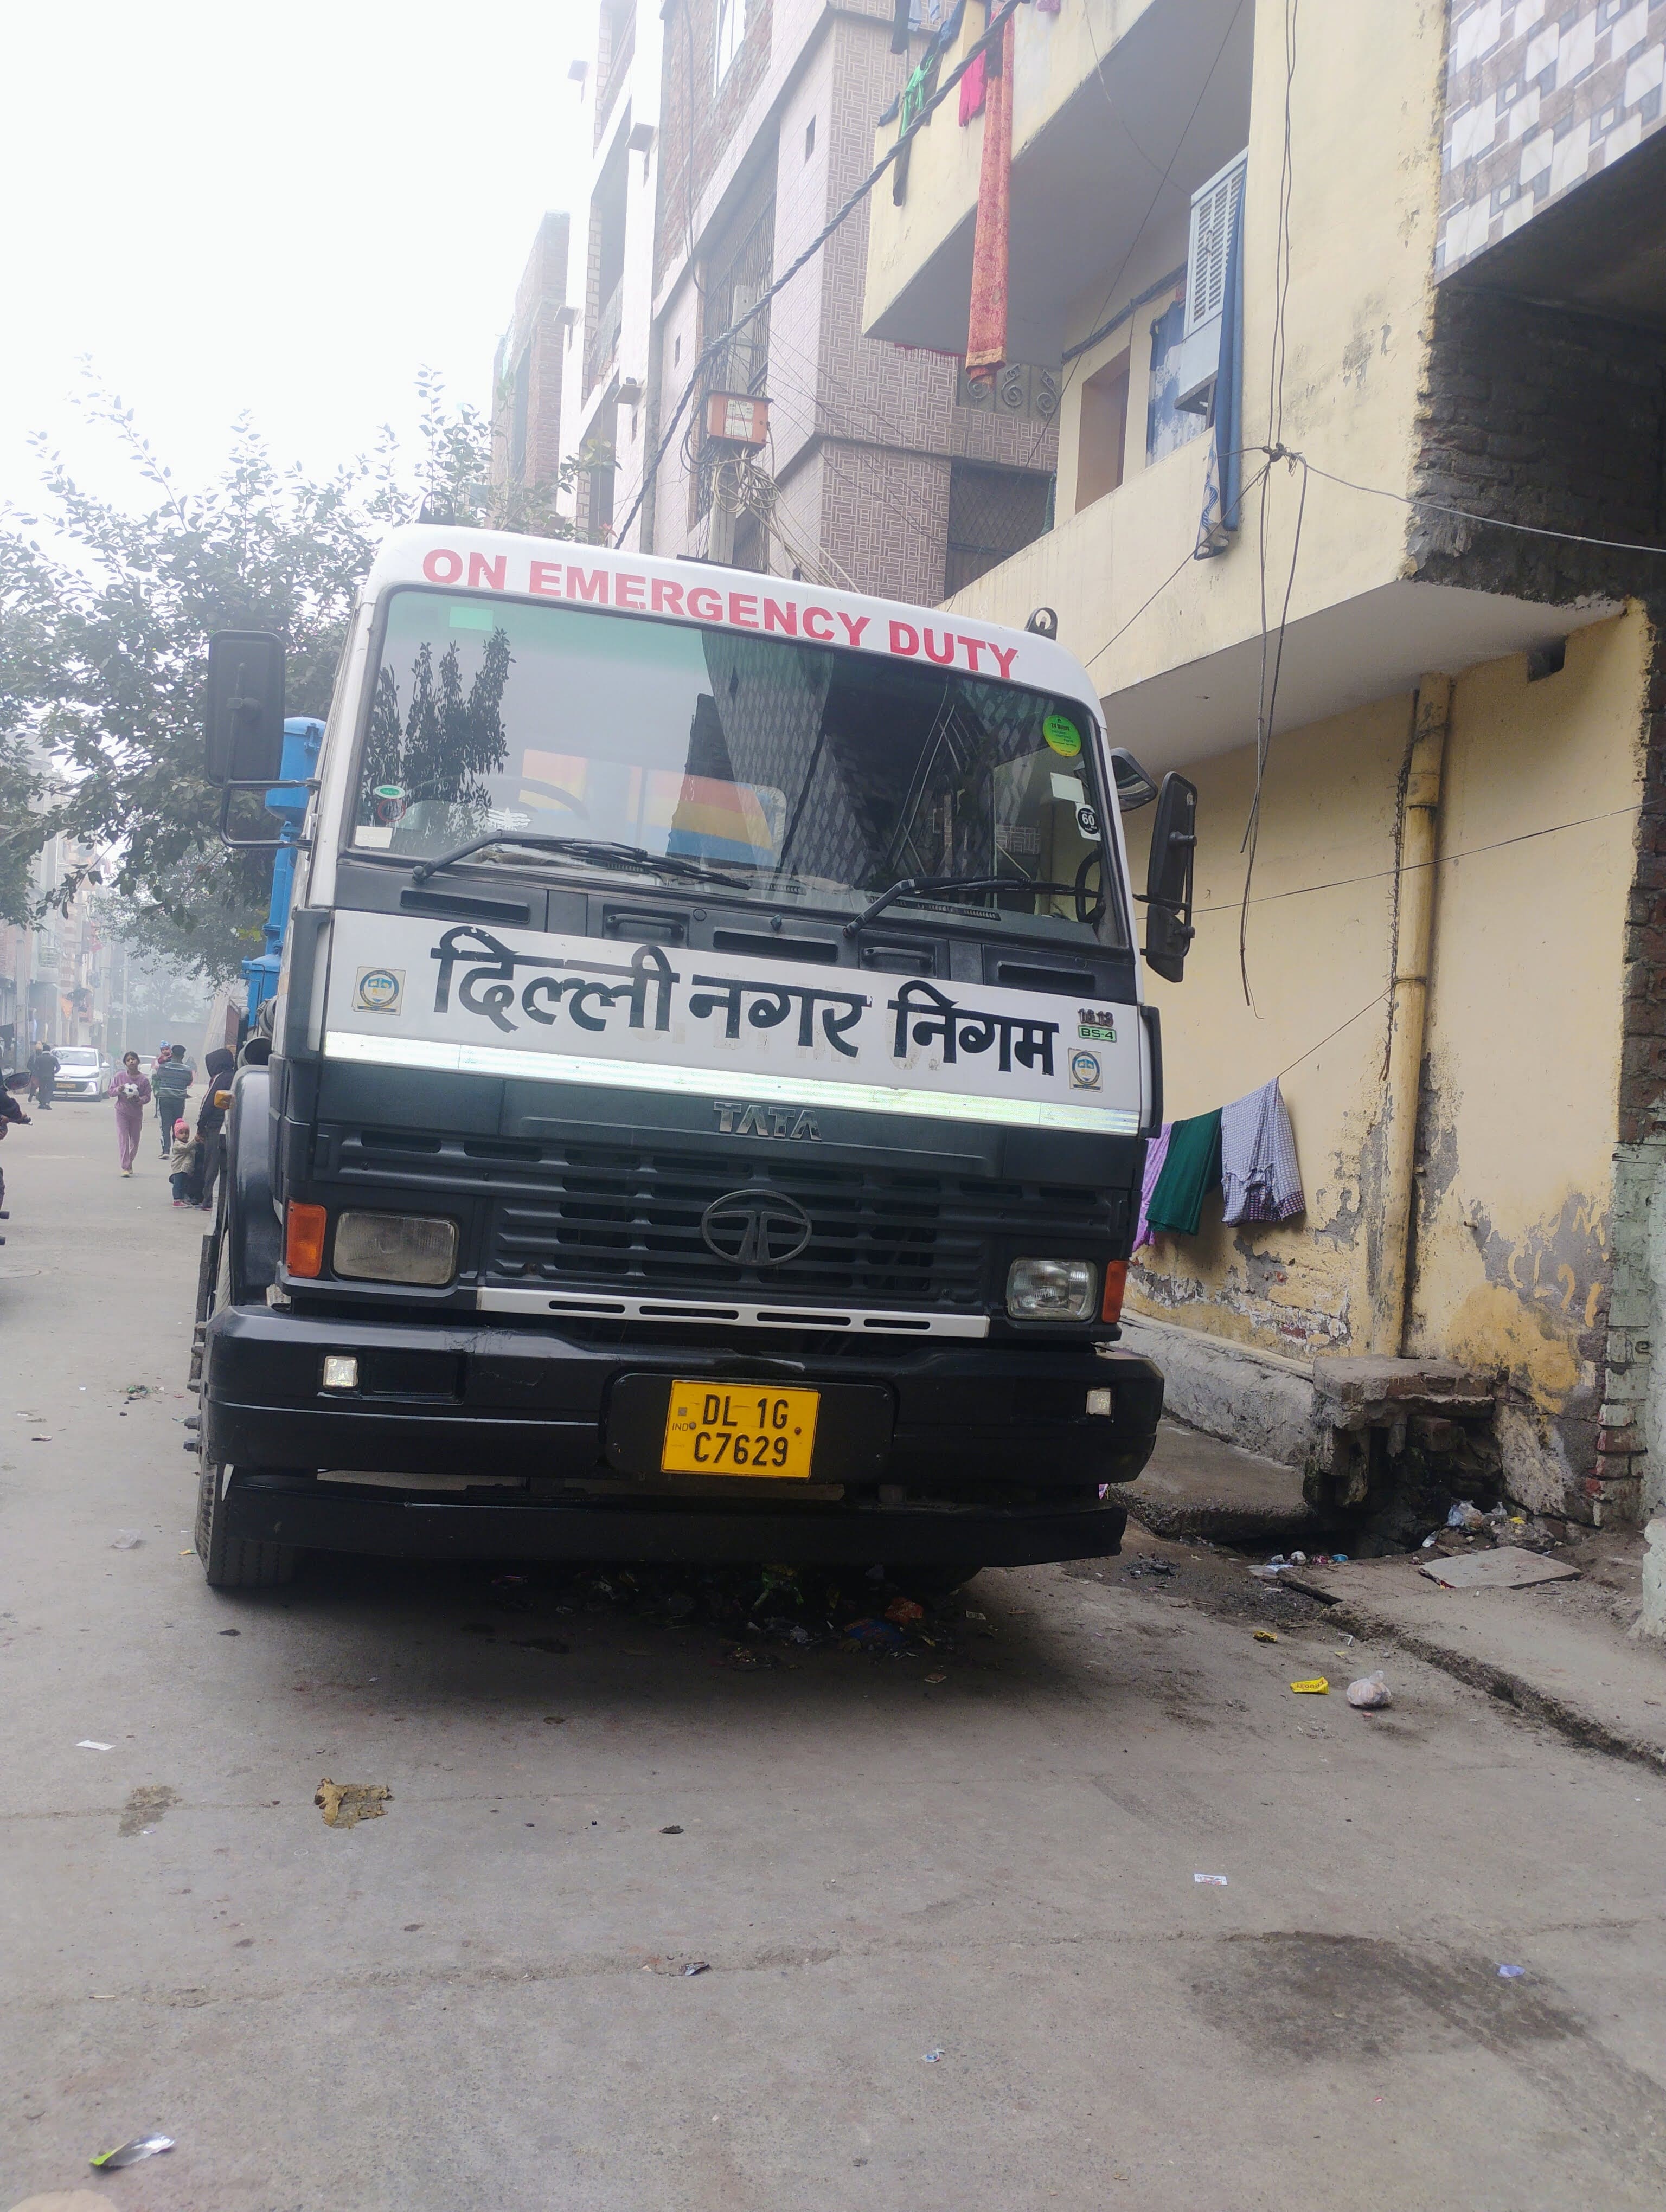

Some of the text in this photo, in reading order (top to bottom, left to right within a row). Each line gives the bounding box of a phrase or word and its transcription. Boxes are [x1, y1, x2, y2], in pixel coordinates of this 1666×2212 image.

[423, 549, 1018, 679] ON EMERGENCY DUTY
[1081, 813, 1095, 826] 60
[430, 926, 1060, 1076] दिल्ली नगर निगम
[1081, 1028, 1113, 1040] BS-4
[713, 1101, 823, 1141] TATA
[672, 1422, 689, 1431] IND
[702, 1394, 789, 1430] DL 1G
[694, 1431, 789, 1467] C7629
